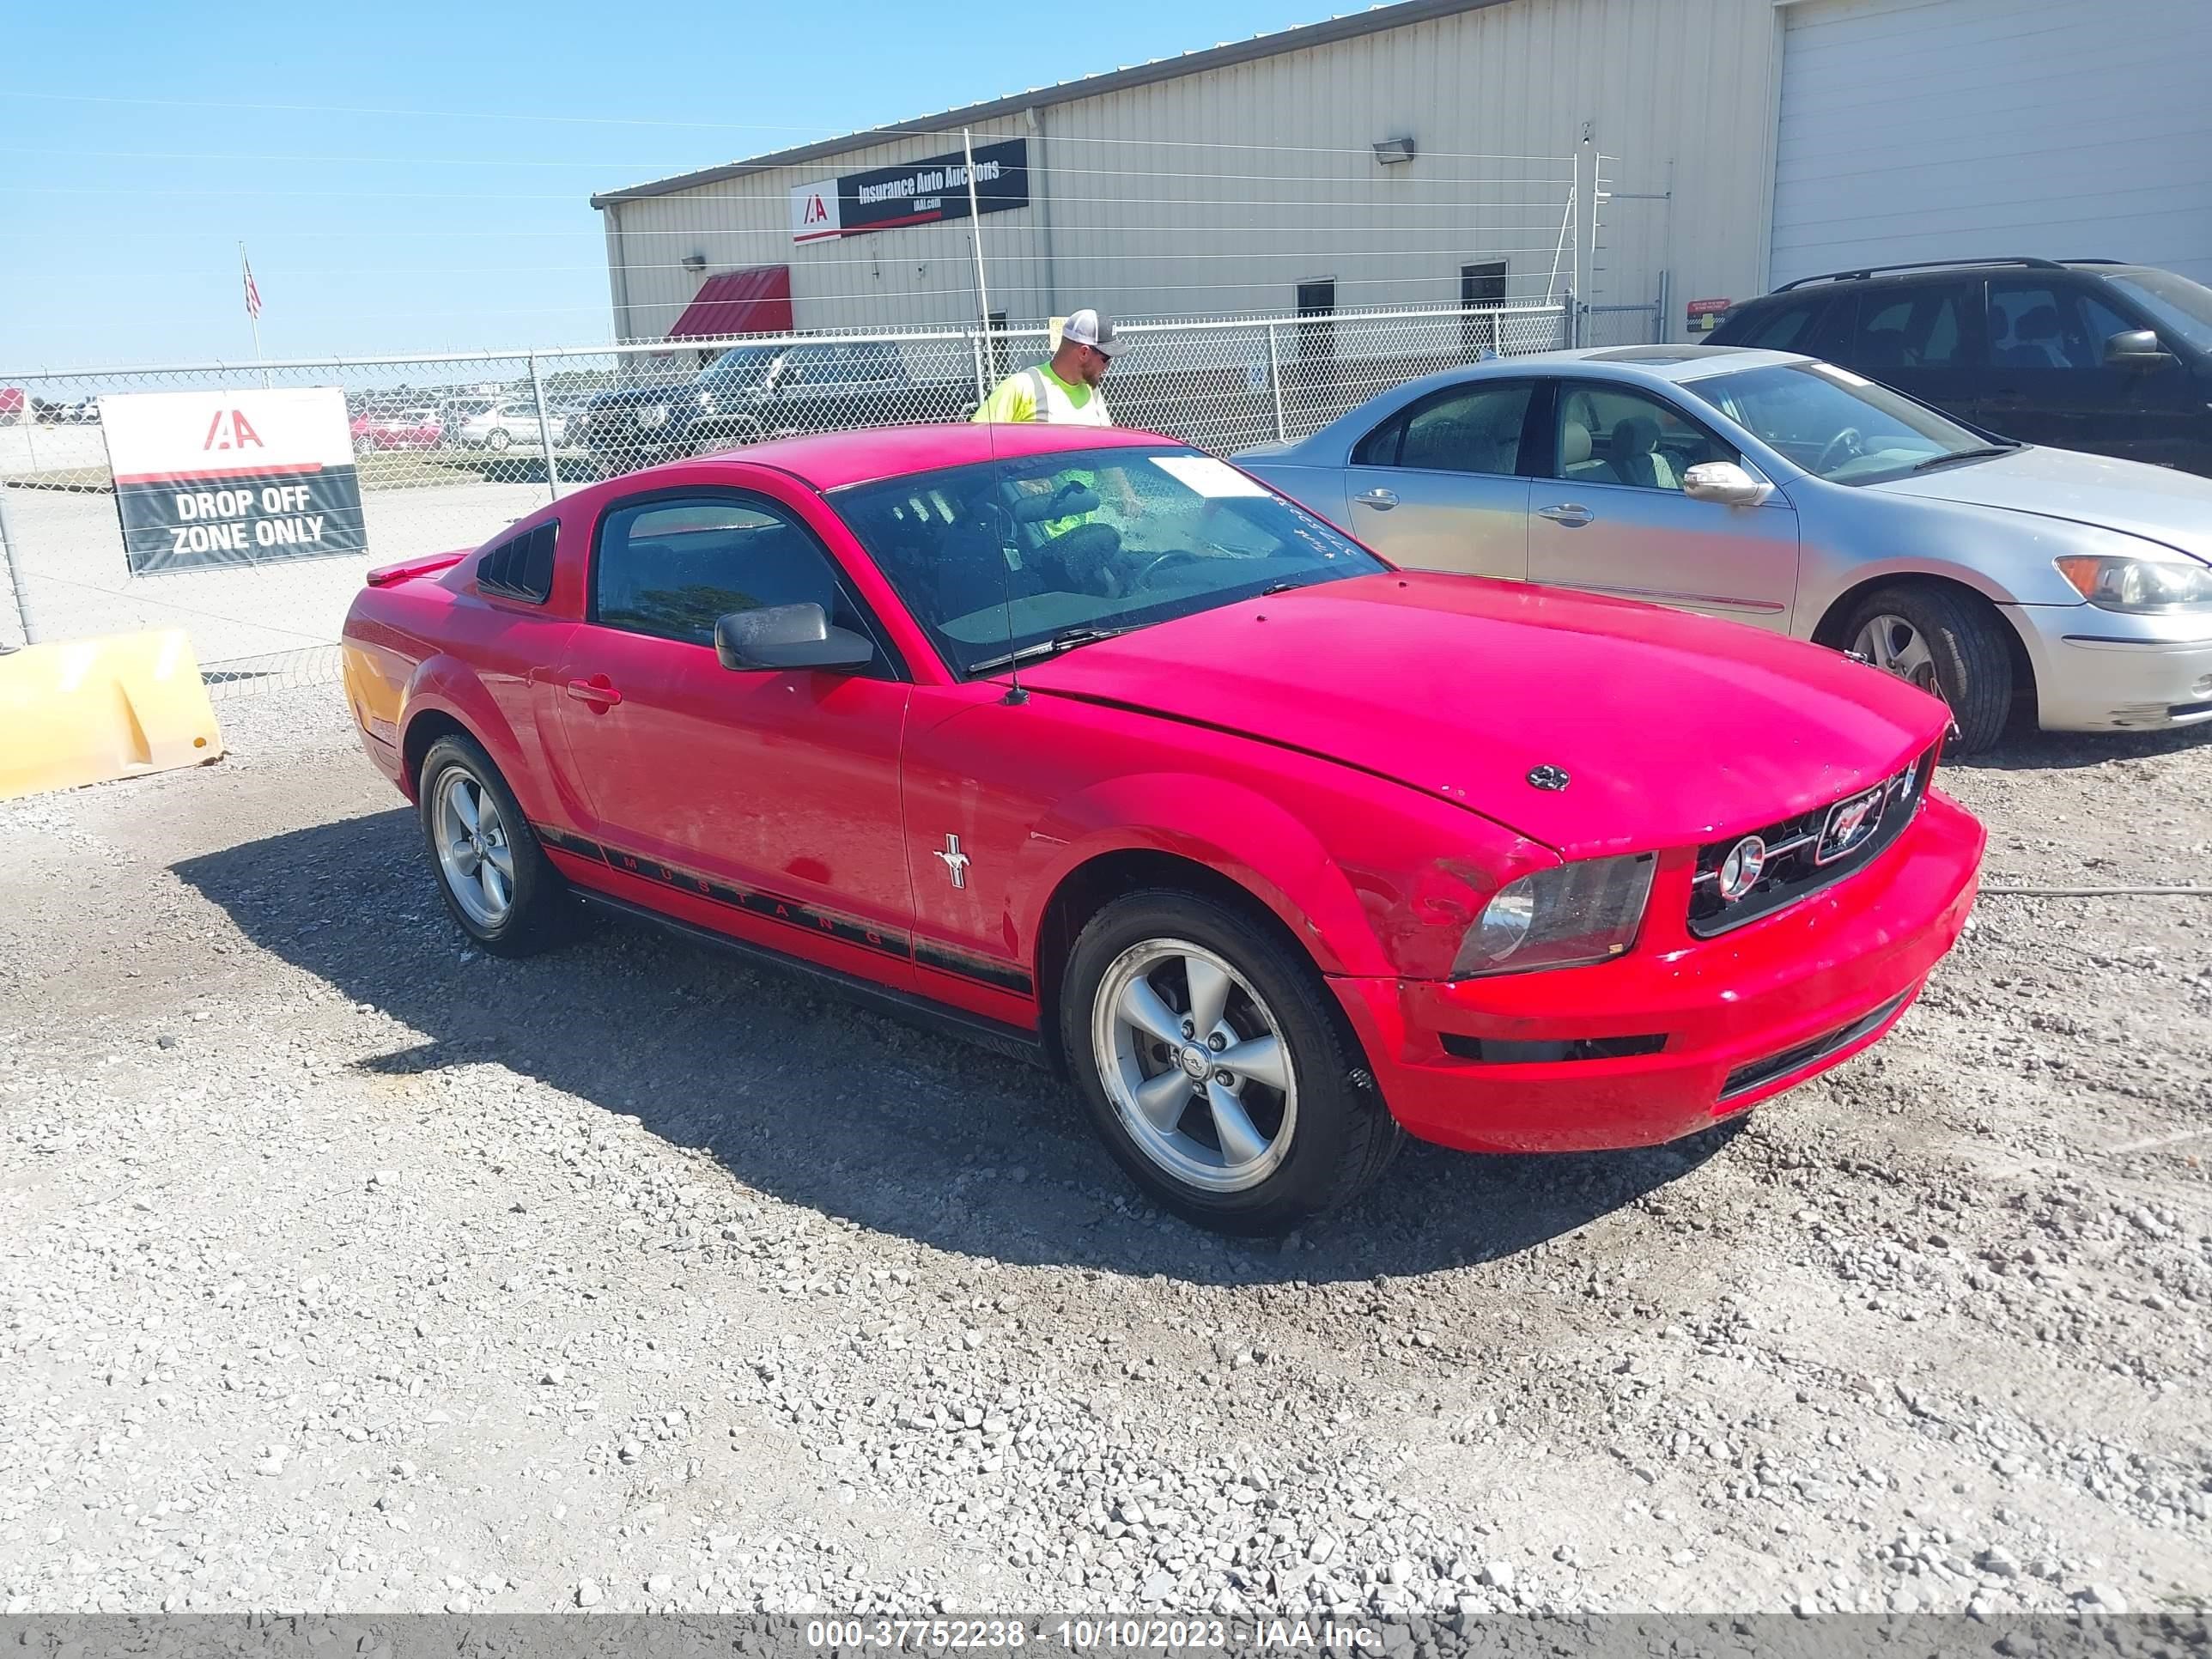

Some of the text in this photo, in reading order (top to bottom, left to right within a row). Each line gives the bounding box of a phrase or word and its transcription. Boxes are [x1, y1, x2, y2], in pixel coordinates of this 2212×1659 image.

[859, 160, 1000, 205] Insurance Auto Aucions
[176, 485, 310, 520] DROP OFF
[170, 515, 324, 555] ZONE ONLY
[623, 857, 881, 945] MUSTANG
